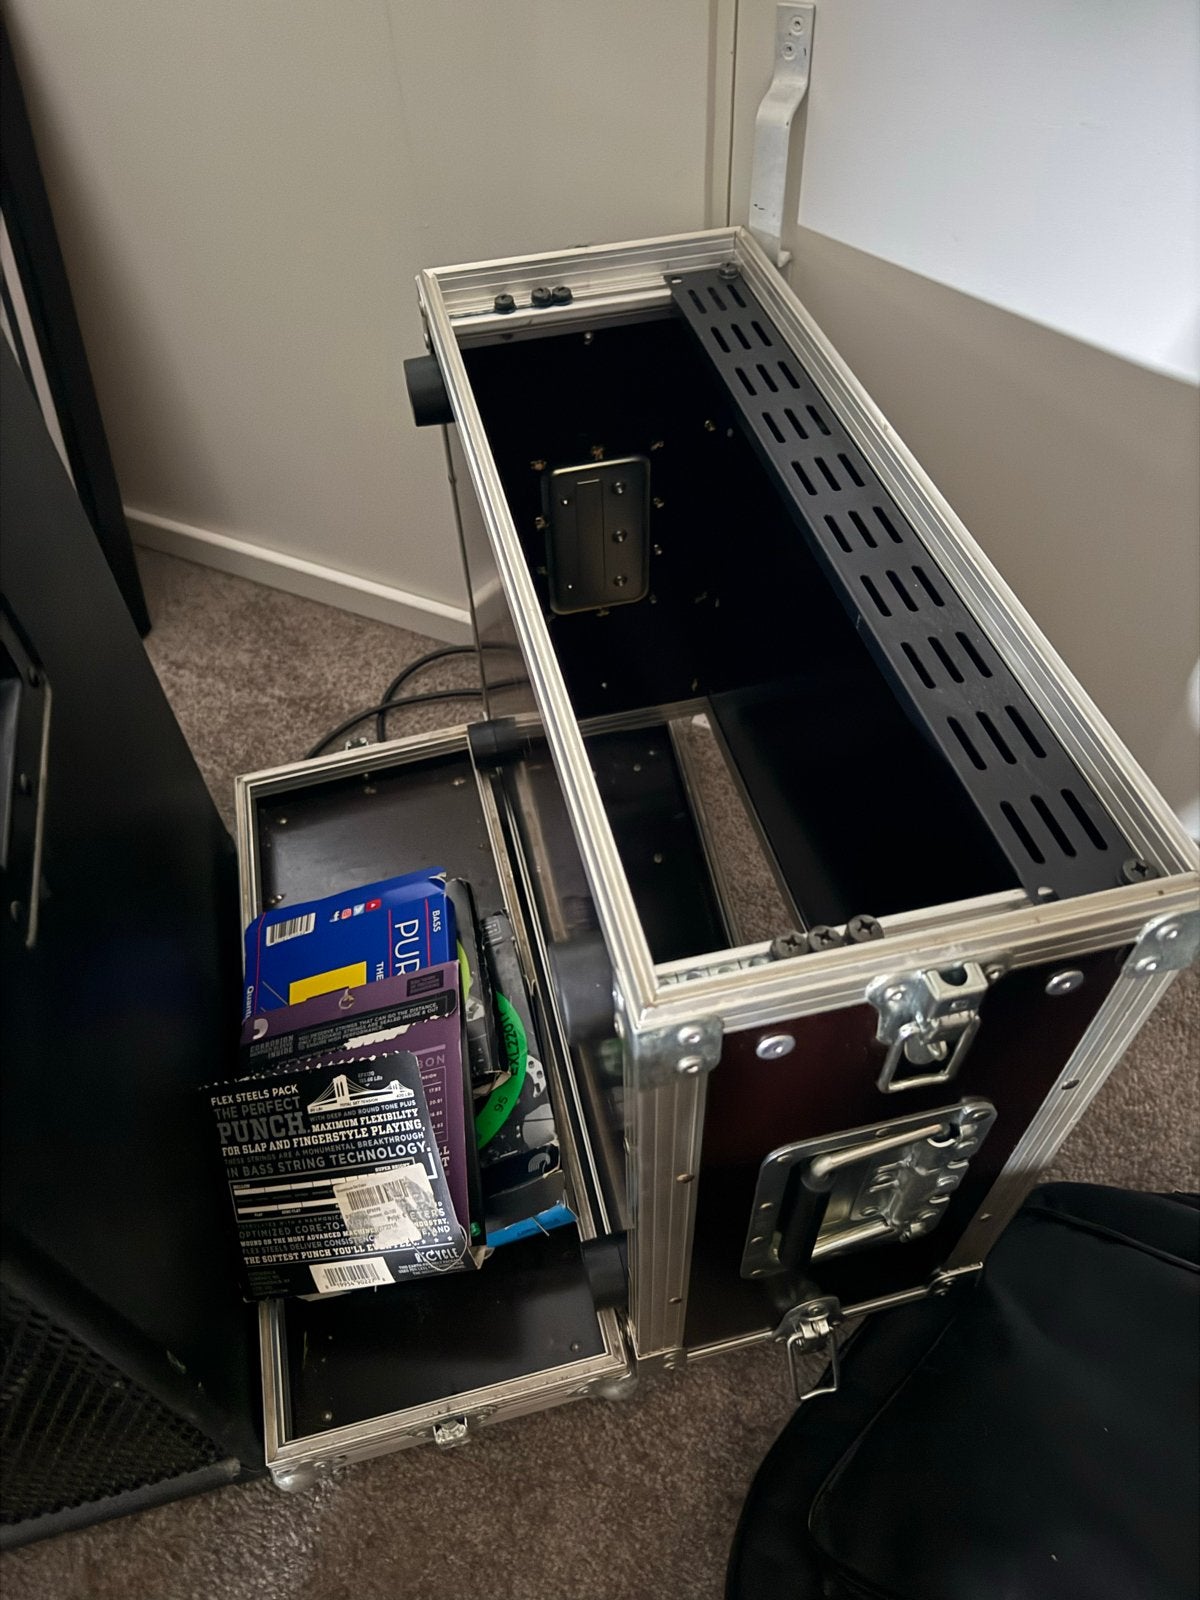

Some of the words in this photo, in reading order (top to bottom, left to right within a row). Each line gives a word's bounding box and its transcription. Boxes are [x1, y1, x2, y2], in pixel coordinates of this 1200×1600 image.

[432, 909, 441, 932] BASS
[375, 961, 384, 982] THE
[359, 1018, 374, 1027] THAT
[374, 1014, 386, 1023] CAN
[398, 1008, 409, 1017] THE
[367, 1022, 379, 1030] ARE
[380, 1017, 401, 1028] SEALED
[402, 1012, 421, 1021] INSIDE
[427, 1006, 438, 1014] OUT
[210, 1094, 234, 1106] FLEX
[236, 1089, 270, 1102] STEELS
[272, 1084, 299, 1097] PACK
[494, 1096, 508, 1113] 95
[214, 1106, 238, 1120] THE
[241, 1096, 300, 1117] PERFECT
[326, 1112, 342, 1120] DEEP
[344, 1108, 357, 1116] AND
[358, 1106, 380, 1114] ROUND
[381, 1103, 398, 1112] TONE
[400, 1100, 416, 1110] PLUS
[311, 1118, 358, 1132] MAXIMUM
[360, 1108, 419, 1126] FLEXIBILITY
[222, 1146, 240, 1157] FOR
[242, 1142, 267, 1155] SLAP
[269, 1140, 290, 1151] AND
[293, 1128, 368, 1148] FINGERSTYLE
[371, 1118, 426, 1137] PLAYING,
[224, 1157, 245, 1165] THESE
[247, 1153, 276, 1163] STRINGS
[278, 1151, 292, 1159] ARE
[302, 1143, 356, 1155] MONUMENTAL
[357, 1131, 424, 1148] BREAKTHROUGH
[226, 1166, 239, 1178] IN
[243, 1163, 274, 1176] BASS
[278, 1156, 326, 1172] STRING
[330, 1140, 431, 1166] TECHNOLOGY.
[304, 1214, 343, 1224] HARMONICA
[239, 1226, 290, 1239] OPTIMIZED
[288, 1236, 304, 1244] MOST
[307, 1232, 341, 1242] ADVANCED
[244, 1256, 261, 1265] THE
[262, 1253, 299, 1263] SOFTEST
[302, 1250, 332, 1259] PUNCH
[332, 1246, 366, 1256] YOU'LL
[262, 1245, 288, 1254] STEELS
[290, 1242, 322, 1252] DELIVER
